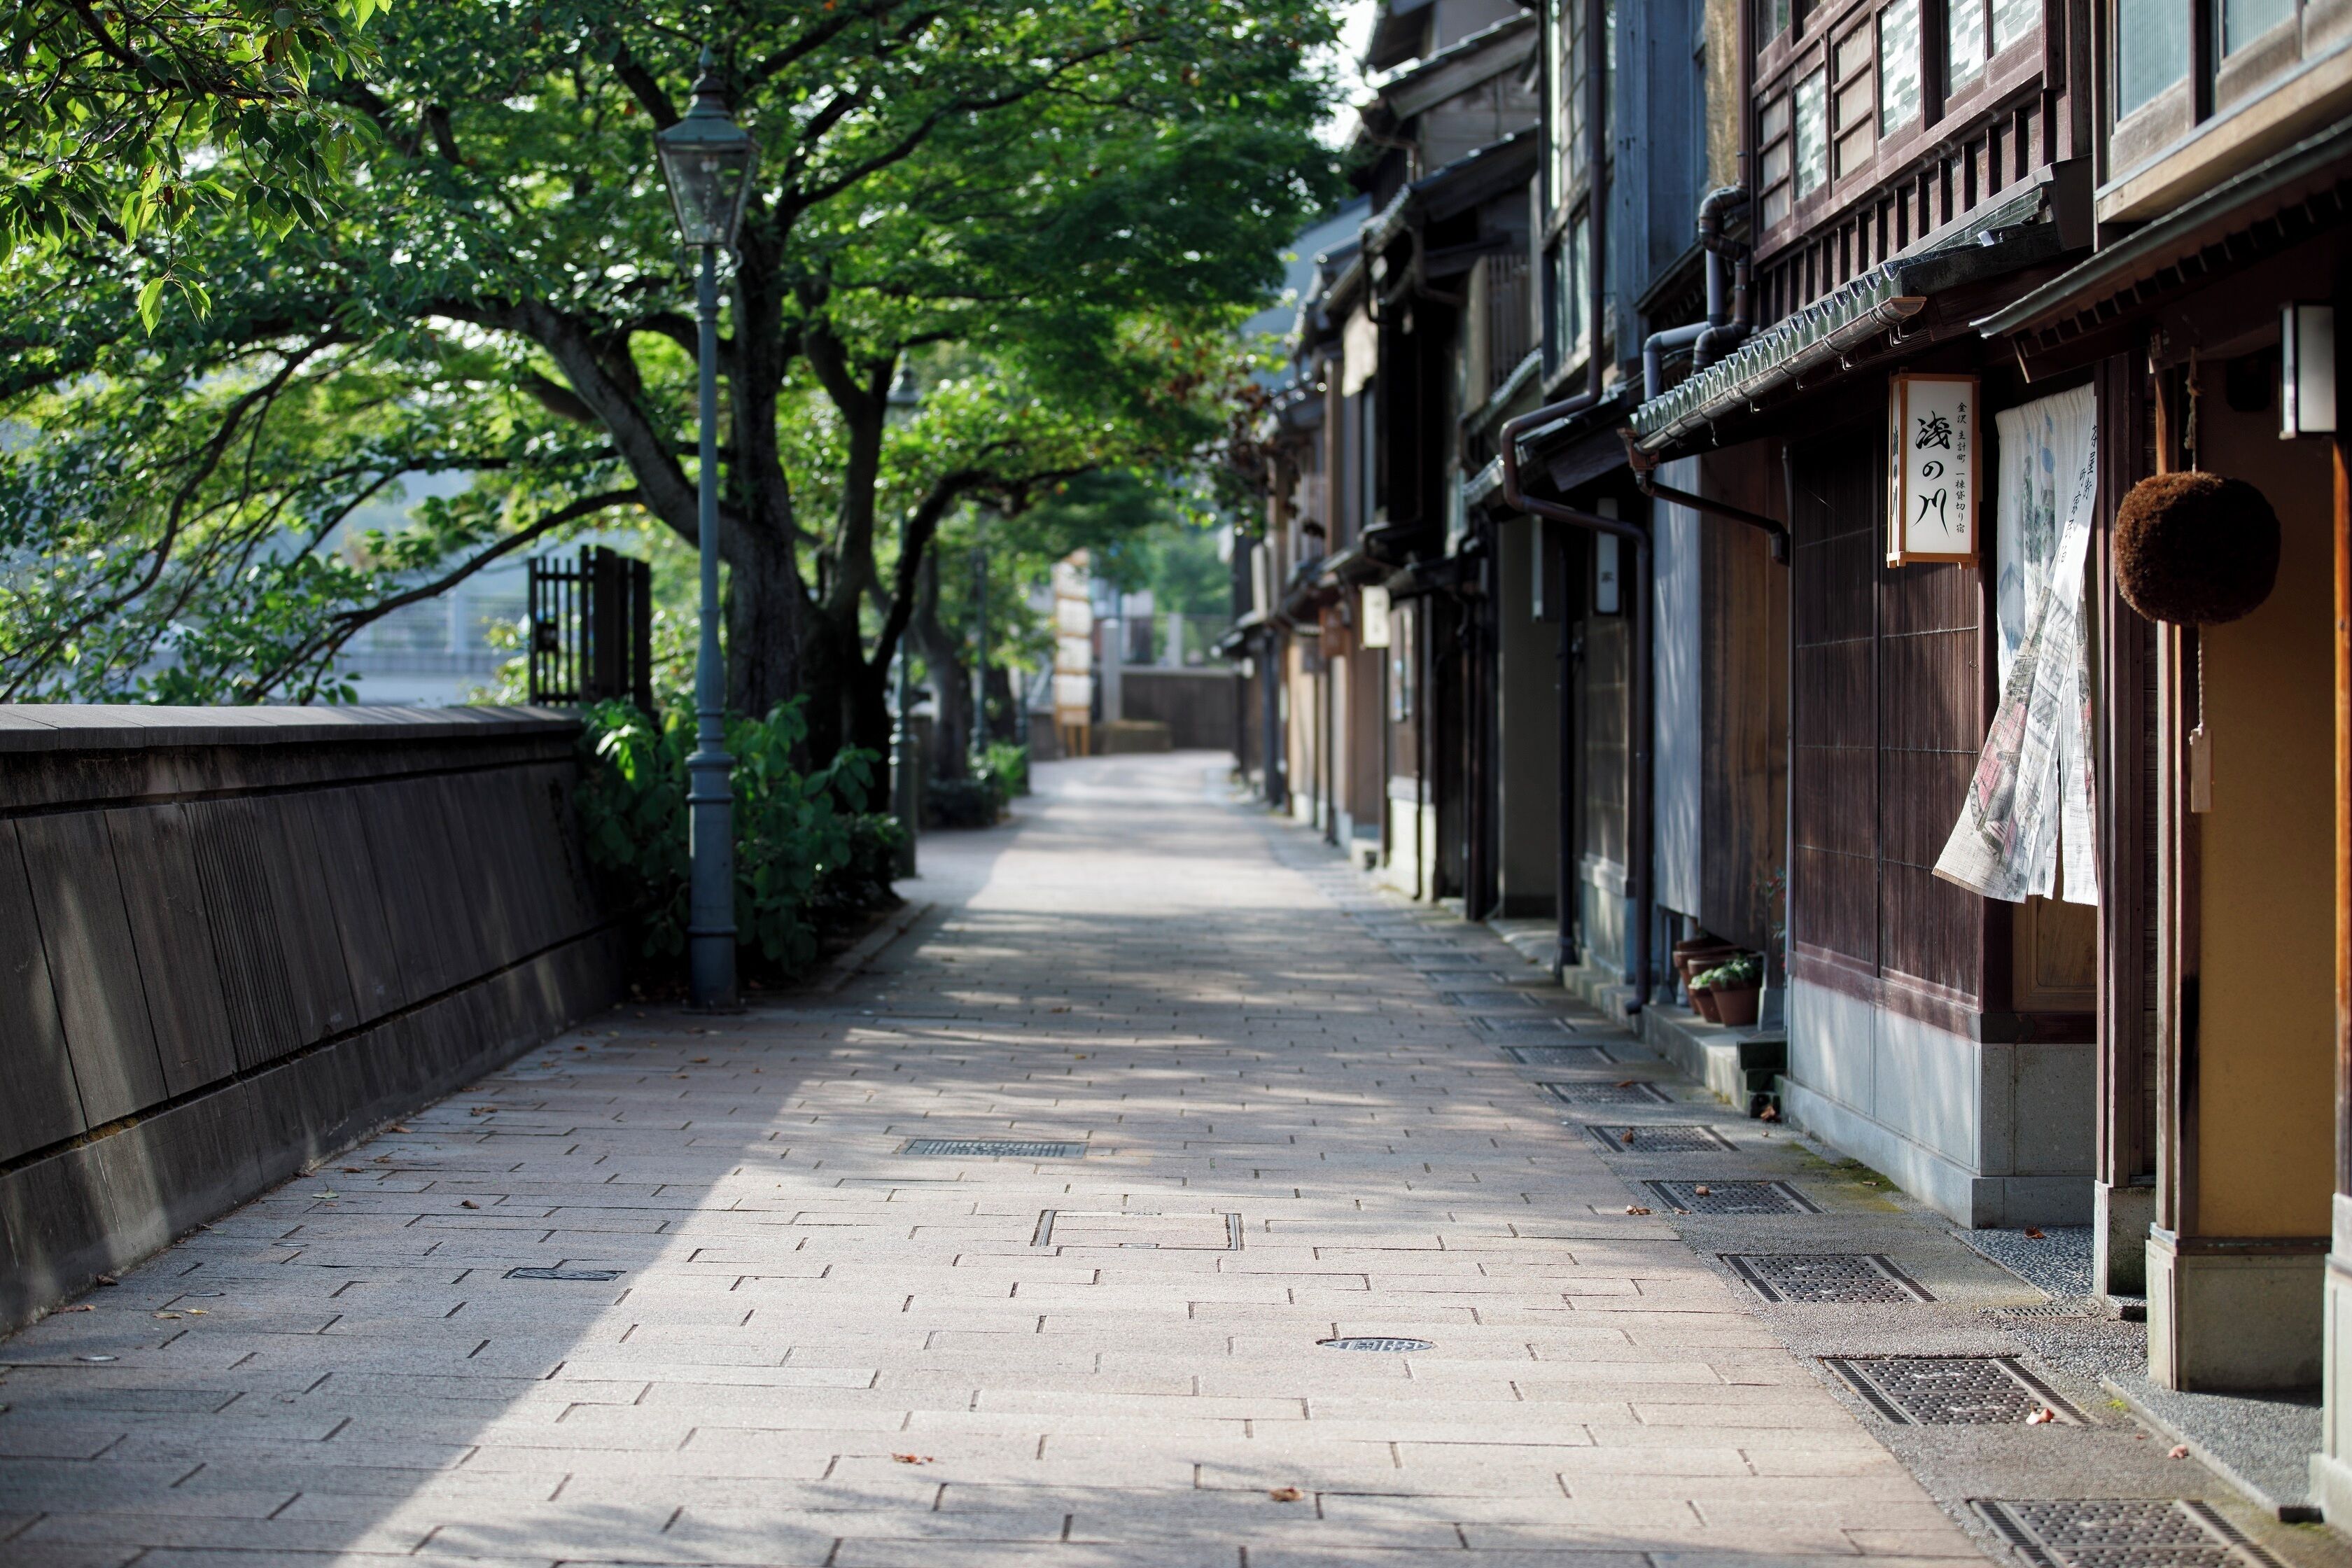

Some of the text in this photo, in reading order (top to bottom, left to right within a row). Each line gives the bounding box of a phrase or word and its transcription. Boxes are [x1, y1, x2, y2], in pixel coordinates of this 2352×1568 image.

[1911, 410, 1952, 538] 浅の川
[1954, 401, 1967, 533] 金沢 主計町 一棟貸切り宿
[2082, 424, 2097, 500] 茶屋街
